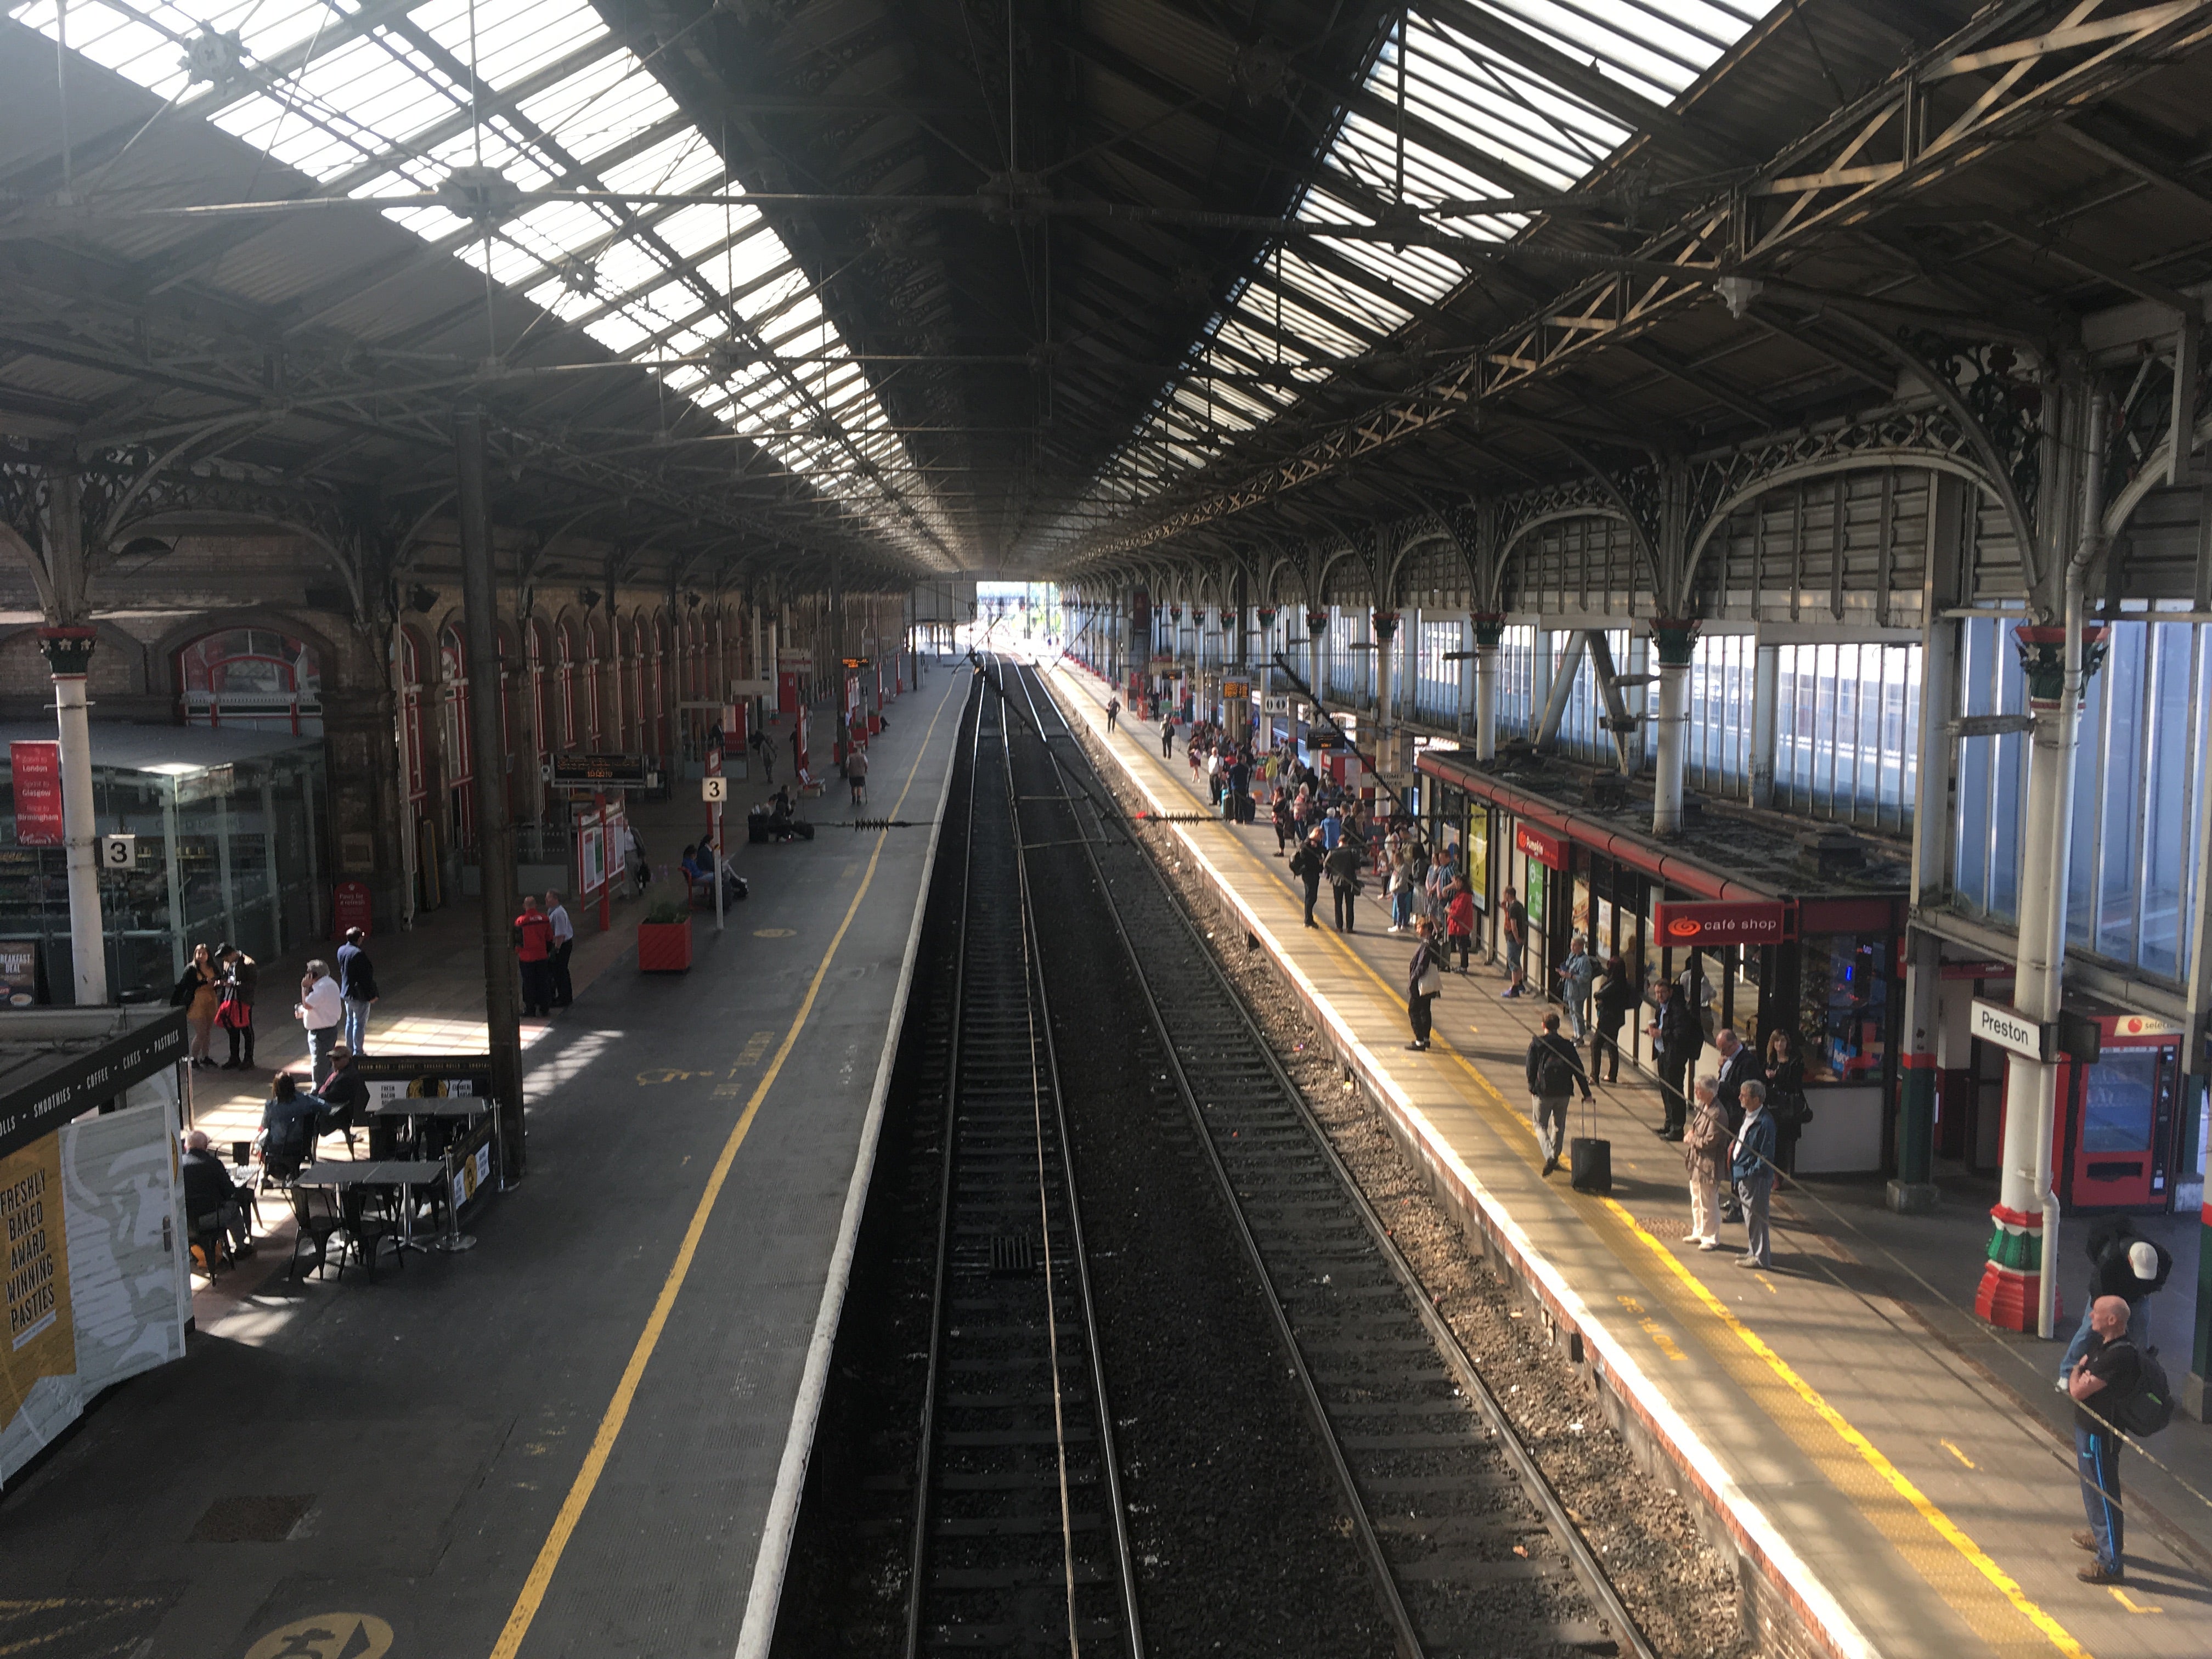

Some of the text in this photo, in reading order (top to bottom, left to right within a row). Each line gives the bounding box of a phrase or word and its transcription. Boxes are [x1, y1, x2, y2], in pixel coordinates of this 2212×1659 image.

[22, 789, 50, 798] Glasgow
[709, 781, 720, 797] 3
[18, 813, 59, 822] Birmingham
[110, 842, 128, 863] 3
[1526, 835, 1543, 857] Pumpkin
[1705, 919, 1776, 931] café shop
[5, 963, 20, 973] DEAL
[1982, 1011, 2028, 1045] Preston
[33, 1086, 71, 1118] SMOOTHIES
[87, 1066, 109, 1091] COFFEE
[123, 1049, 141, 1070] CAKES
[154, 1029, 179, 1054] PASTRIES
[0, 1167, 46, 1218] FRESHLY
[8, 1200, 43, 1244] BAKED
[10, 1229, 46, 1273] AWARD
[6, 1252, 53, 1306] WINNING
[10, 1282, 55, 1335] PASTIES
